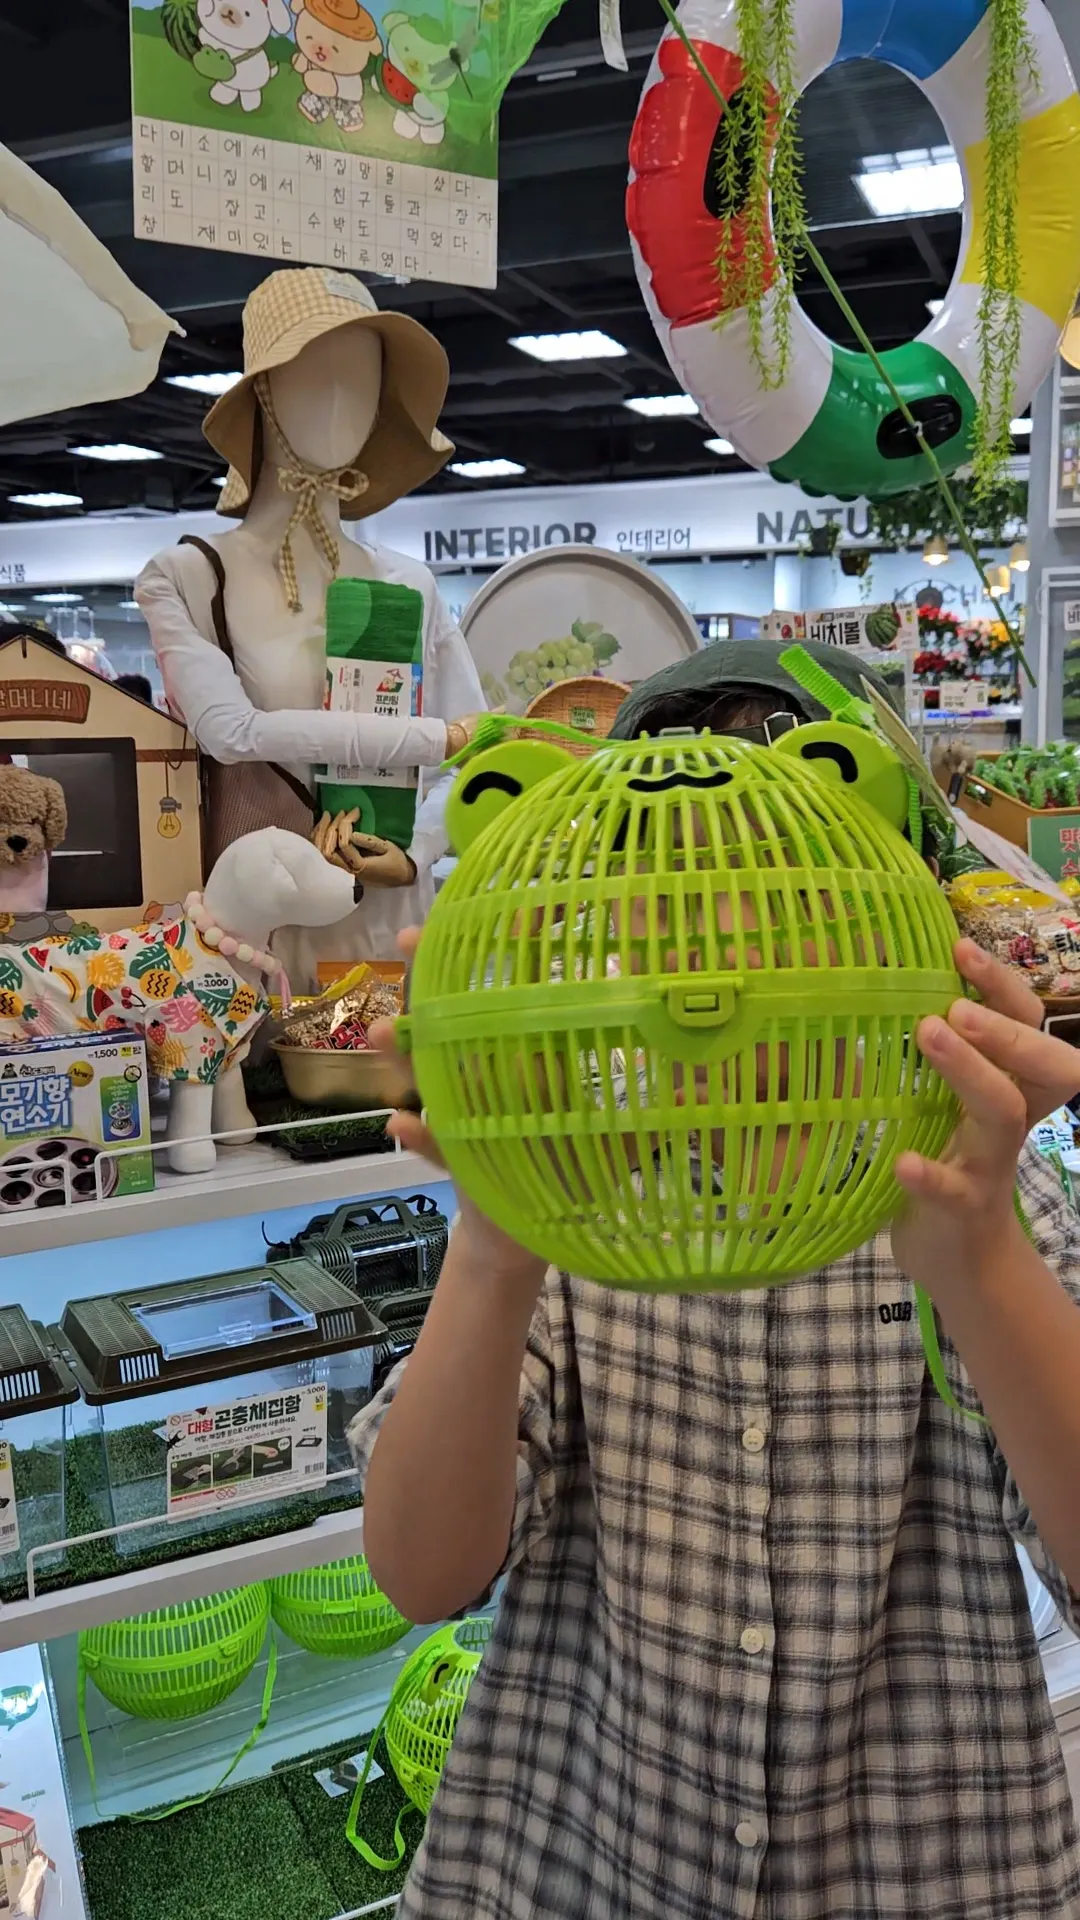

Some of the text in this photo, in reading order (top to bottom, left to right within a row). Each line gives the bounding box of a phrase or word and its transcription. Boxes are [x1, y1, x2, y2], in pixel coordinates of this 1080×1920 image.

[140, 124, 481, 200] 다이소에서 채집망을 샀다.
[141, 185, 184, 209] 리도
[308, 212, 371, 238] 수박도
[406, 227, 481, 255] 먹었다.
[333, 187, 421, 217] 친구들과
[455, 208, 494, 227] 잠자
[142, 214, 433, 274] 참 재미있는 하루였다.
[424, 522, 692, 562] INTERIOR 인테리어
[810, 621, 860, 646] 비치볼
[0, 1076, 70, 1107] 모기향
[0, 1100, 70, 1133] 연소기
[187, 1417, 214, 1436] 대형
[214, 1394, 302, 1430] 곤충채집함
